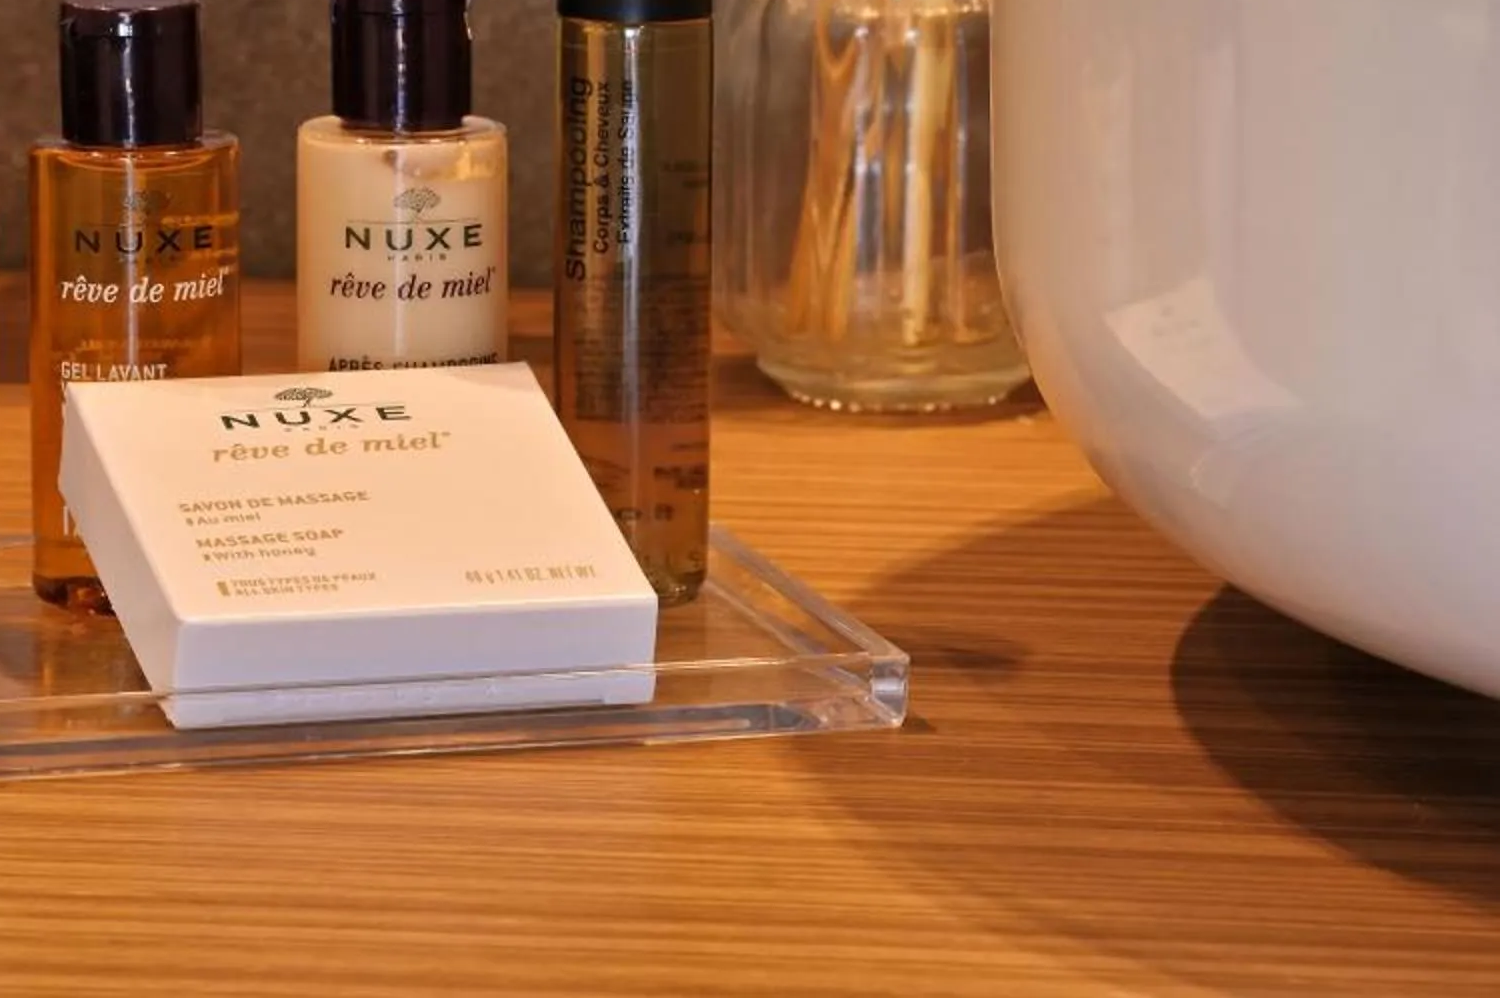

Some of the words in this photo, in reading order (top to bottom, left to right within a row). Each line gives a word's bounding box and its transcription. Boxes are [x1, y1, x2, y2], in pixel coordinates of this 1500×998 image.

[594, 81, 610, 167] Cheveux
[566, 77, 593, 281] Shampooing
[345, 224, 483, 251] NUXE
[594, 194, 612, 254] Corps
[75, 225, 213, 254] NUXE
[61, 274, 119, 303] rêve
[130, 275, 165, 303] de
[330, 272, 386, 300] rêve
[397, 274, 432, 301] de
[61, 361, 93, 380] GEL
[96, 363, 168, 382] LAVANT
[220, 405, 412, 430] NUXE
[212, 442, 290, 463] rêve
[305, 437, 349, 456] de
[363, 432, 441, 453] miel
[179, 499, 242, 514] SAVON
[249, 497, 274, 510] DE
[278, 491, 371, 507] MASSAGE
[195, 531, 290, 549] MASSAGE
[292, 528, 344, 542] SOAP
